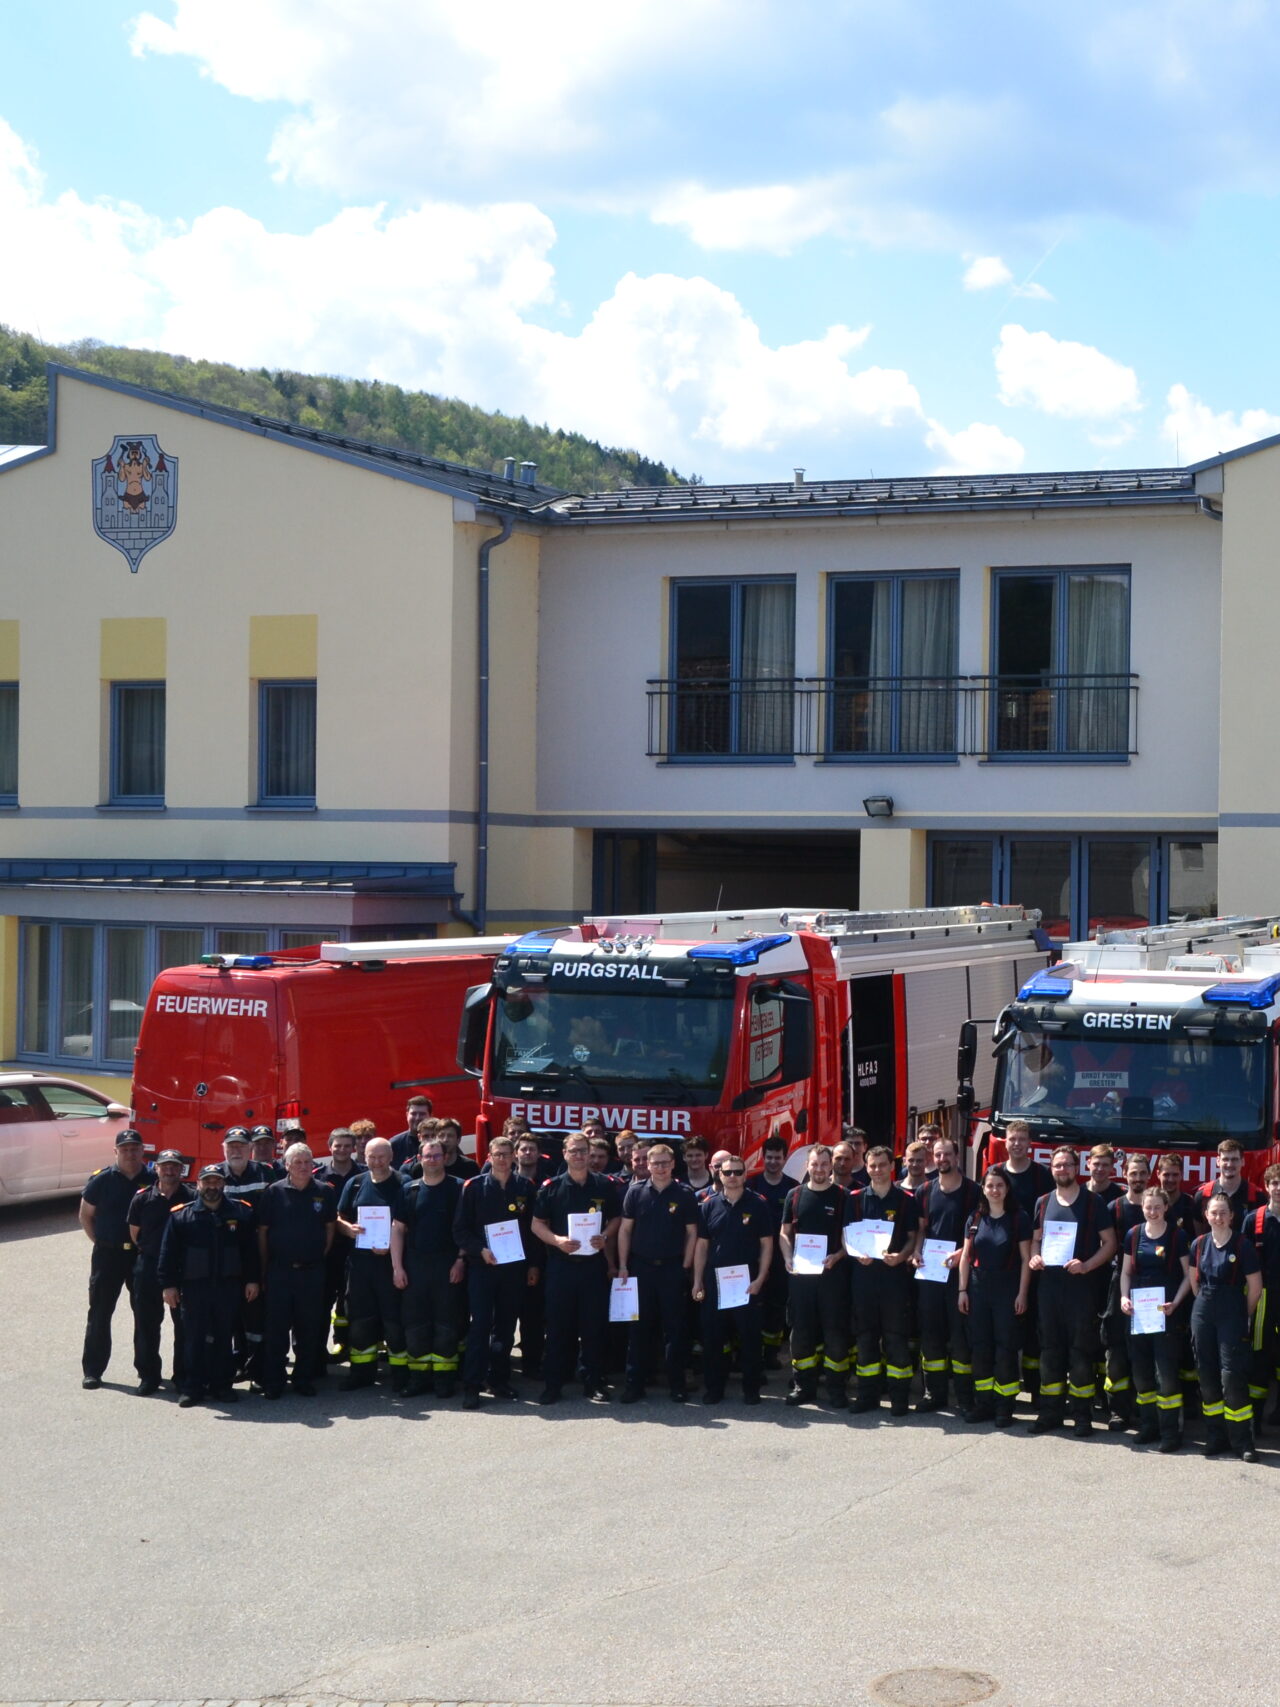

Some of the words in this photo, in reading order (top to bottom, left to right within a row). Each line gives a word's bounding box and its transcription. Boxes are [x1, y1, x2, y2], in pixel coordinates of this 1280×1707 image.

[551, 962, 663, 980] PURGSTALL
[156, 995, 268, 1017] FEUERWEHR
[1082, 1012, 1172, 1030] GRESTEN
[511, 1103, 691, 1131] FEUERWEHR
